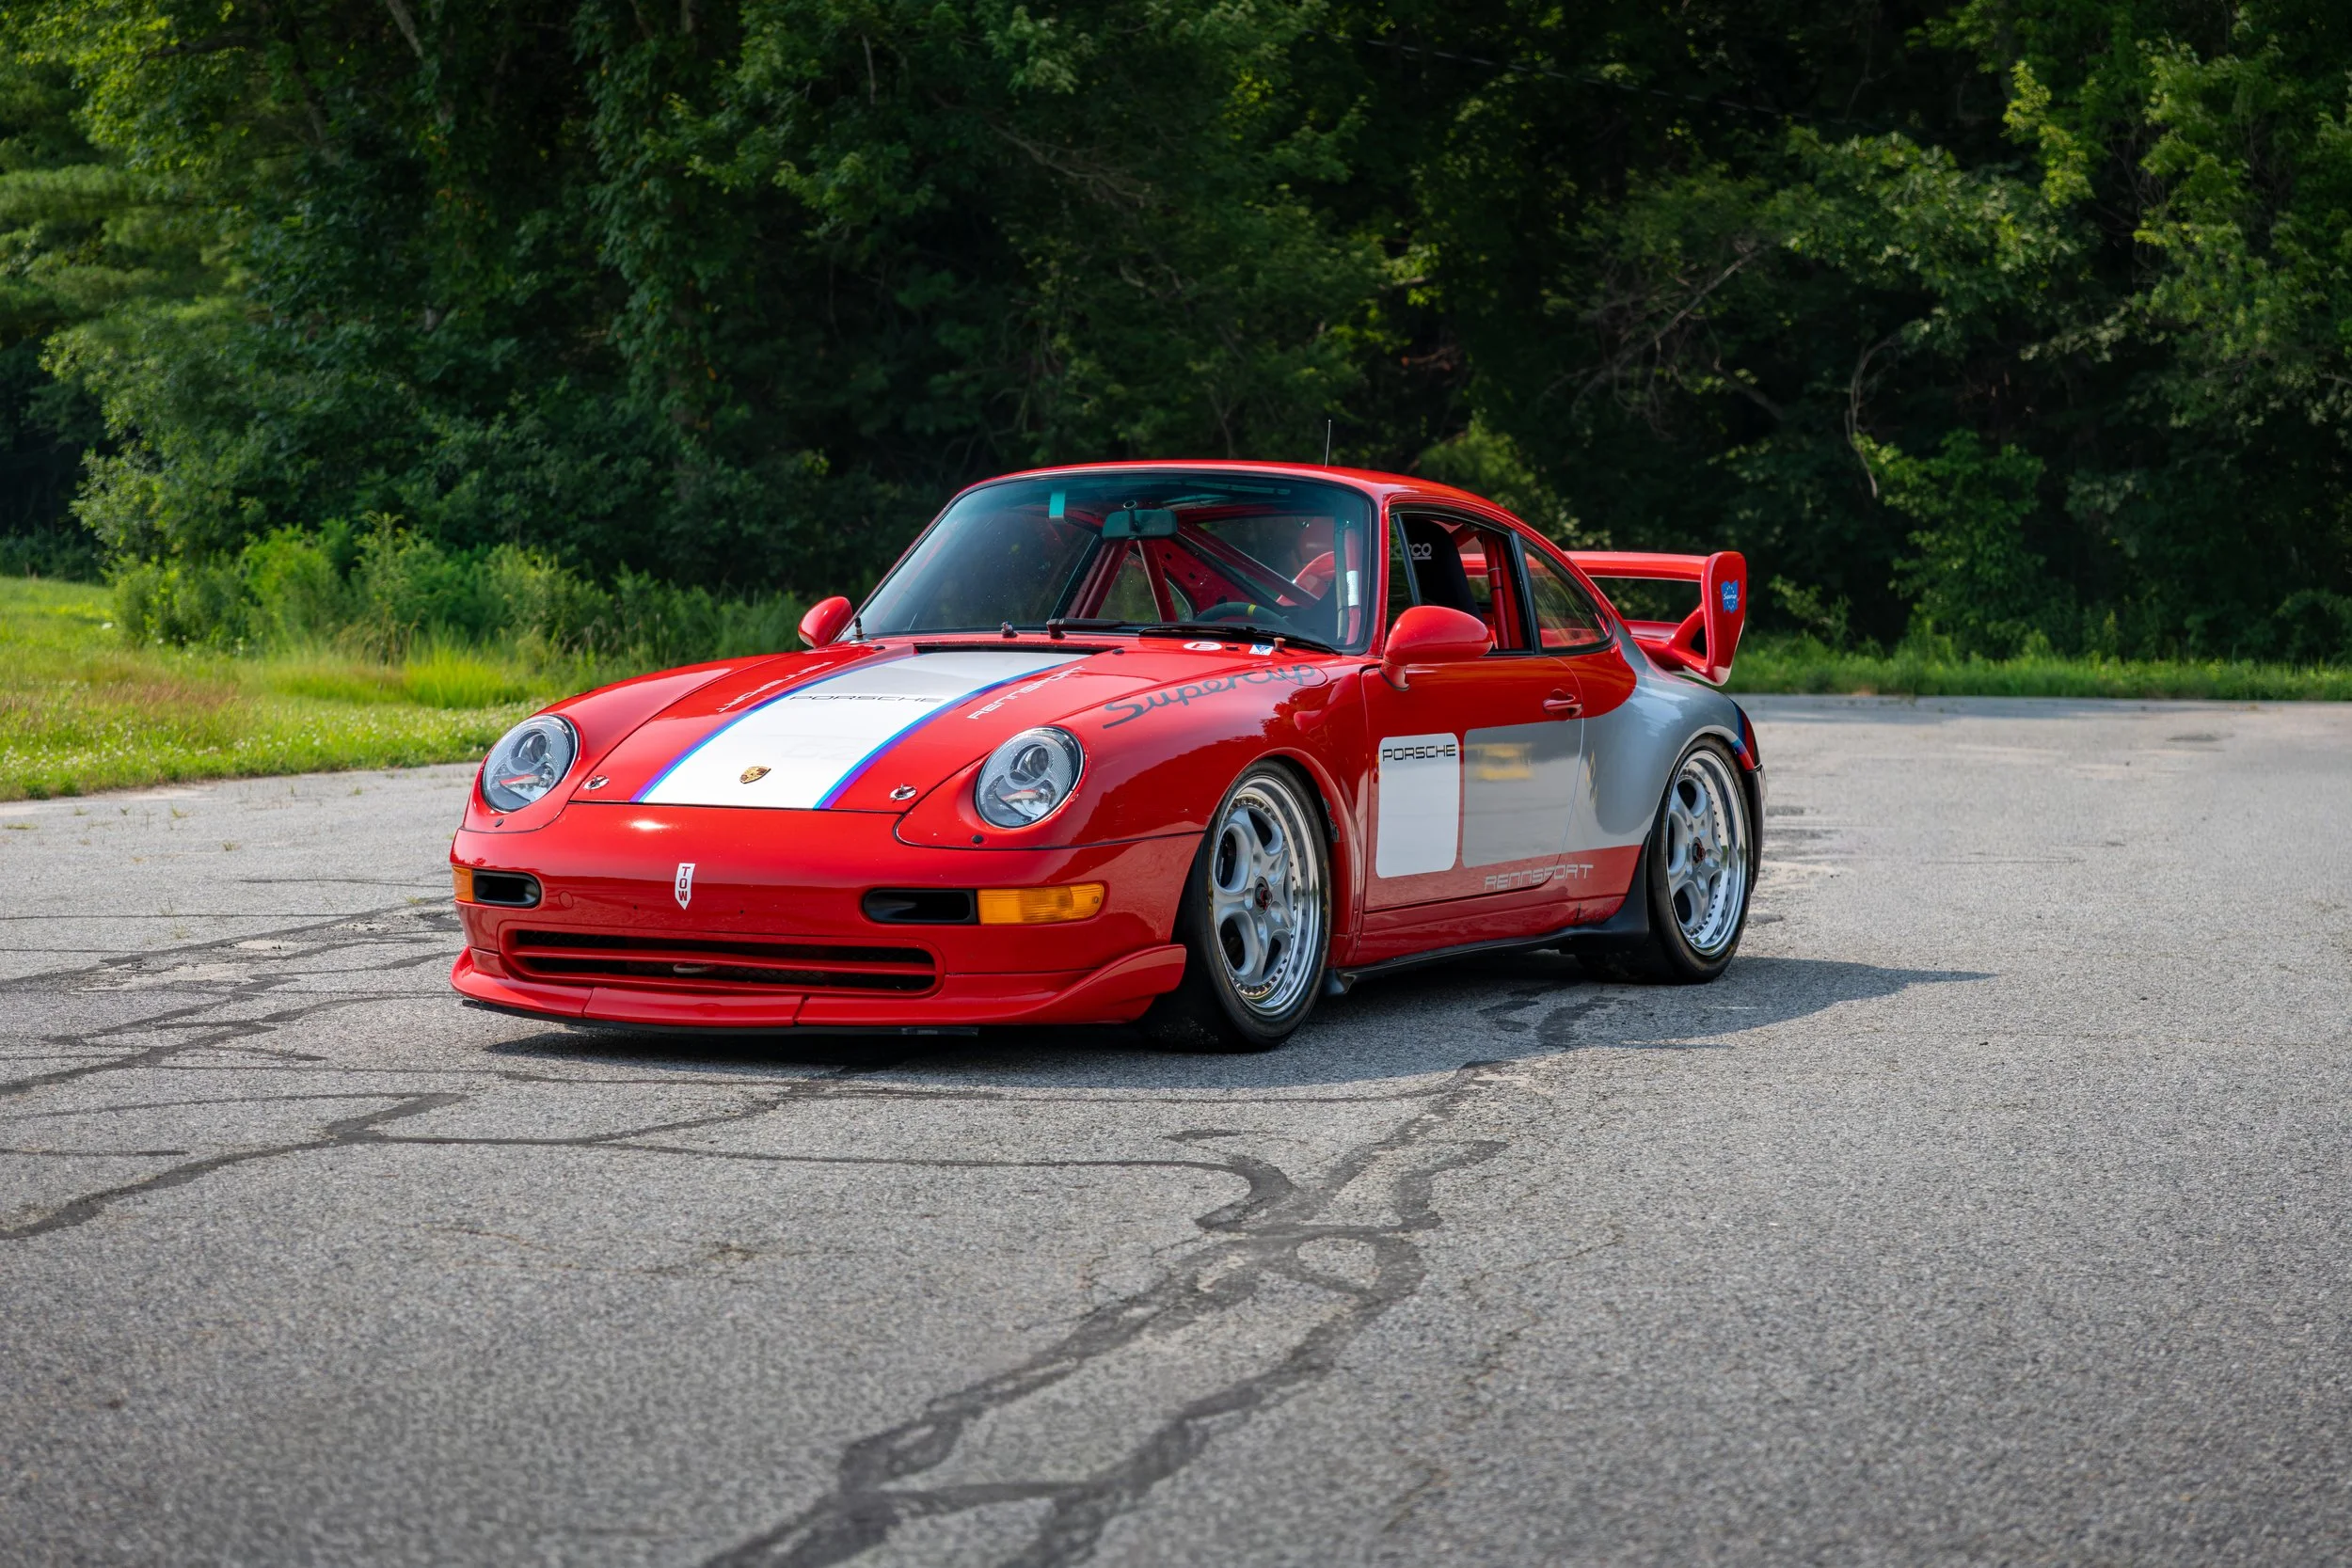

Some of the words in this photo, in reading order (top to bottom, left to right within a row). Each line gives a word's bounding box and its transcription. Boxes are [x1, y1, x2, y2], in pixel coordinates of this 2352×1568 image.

[966, 665, 1086, 720] RENNSPORT
[1103, 664, 1316, 729] Supercup
[1382, 744, 1456, 762] PORSCHE
[678, 866, 691, 901] TOW
[1484, 864, 1594, 891] RENNSPORT
